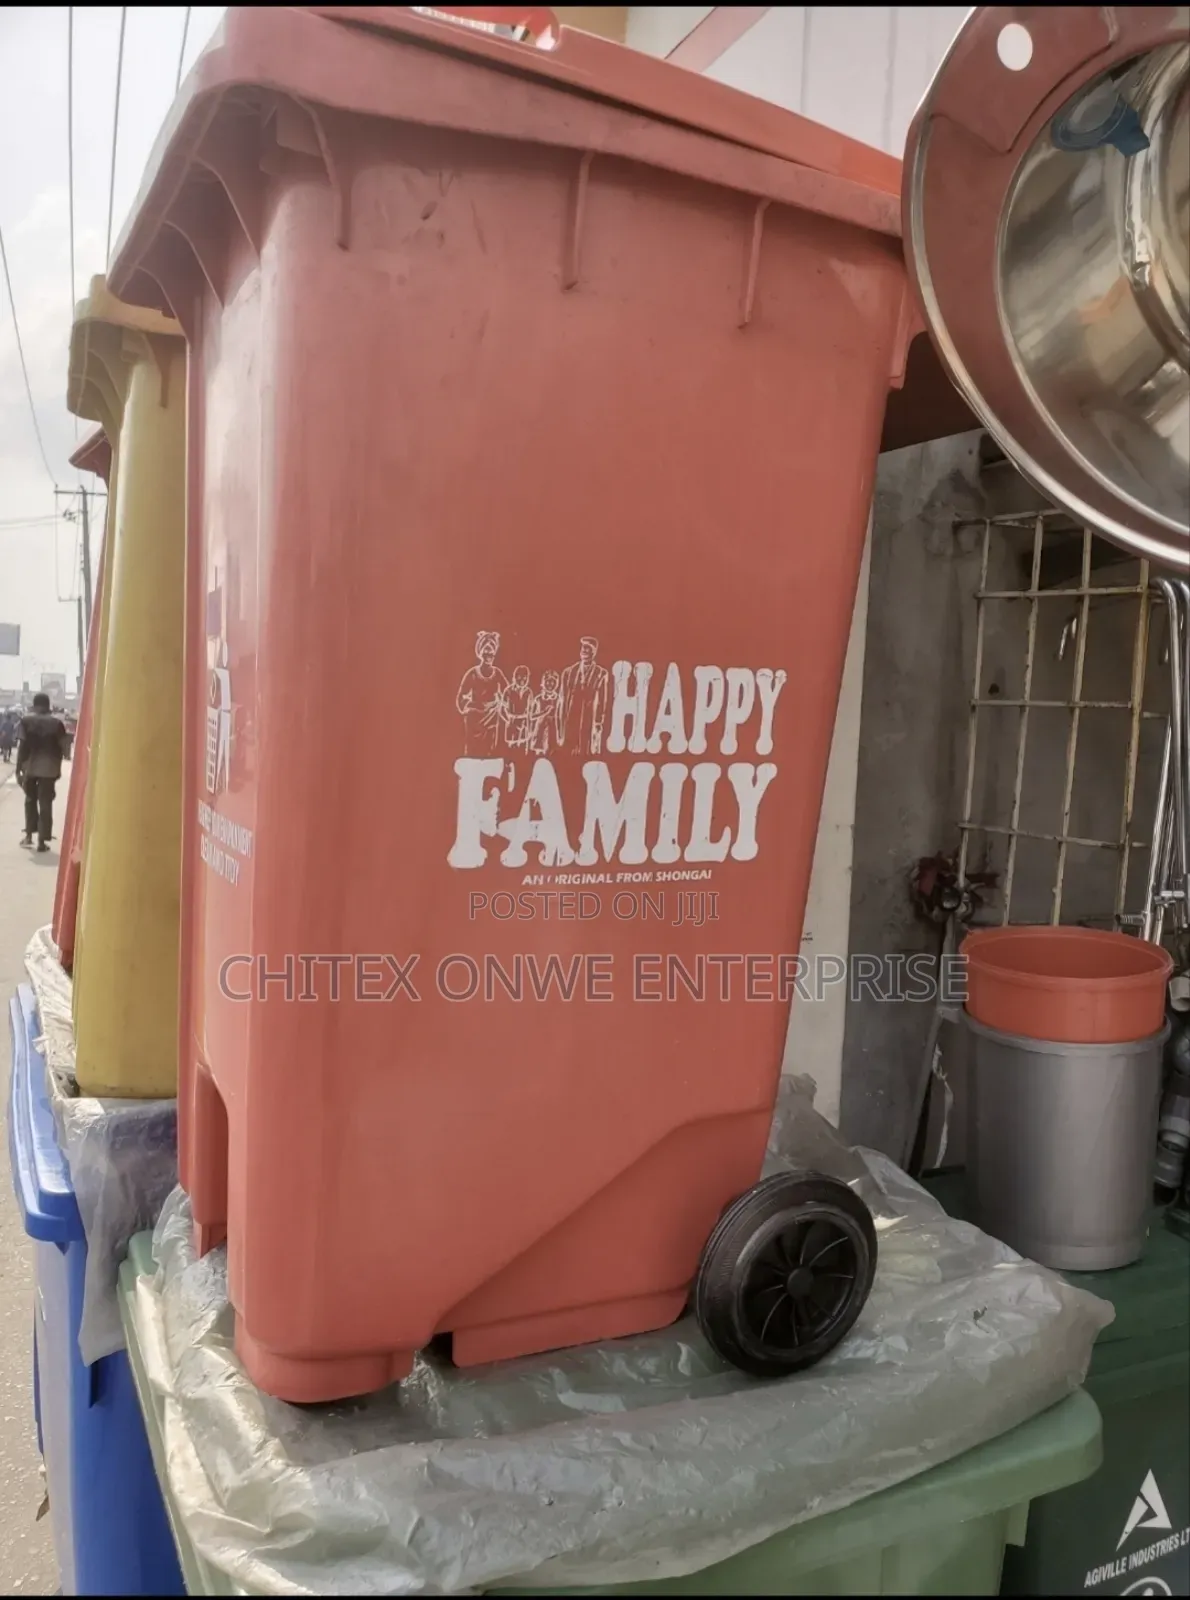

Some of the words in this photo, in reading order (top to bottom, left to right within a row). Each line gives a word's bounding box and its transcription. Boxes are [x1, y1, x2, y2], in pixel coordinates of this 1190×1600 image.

[606, 660, 787, 755] HAPPY
[447, 757, 778, 869] FAMILY
[521, 874, 544, 885] AN
[616, 871, 653, 883] FROM
[655, 869, 712, 882] SHONGAI
[1083, 1556, 1128, 1589] AGIVILLE
[1128, 1532, 1181, 1571] INDUSTRIES
